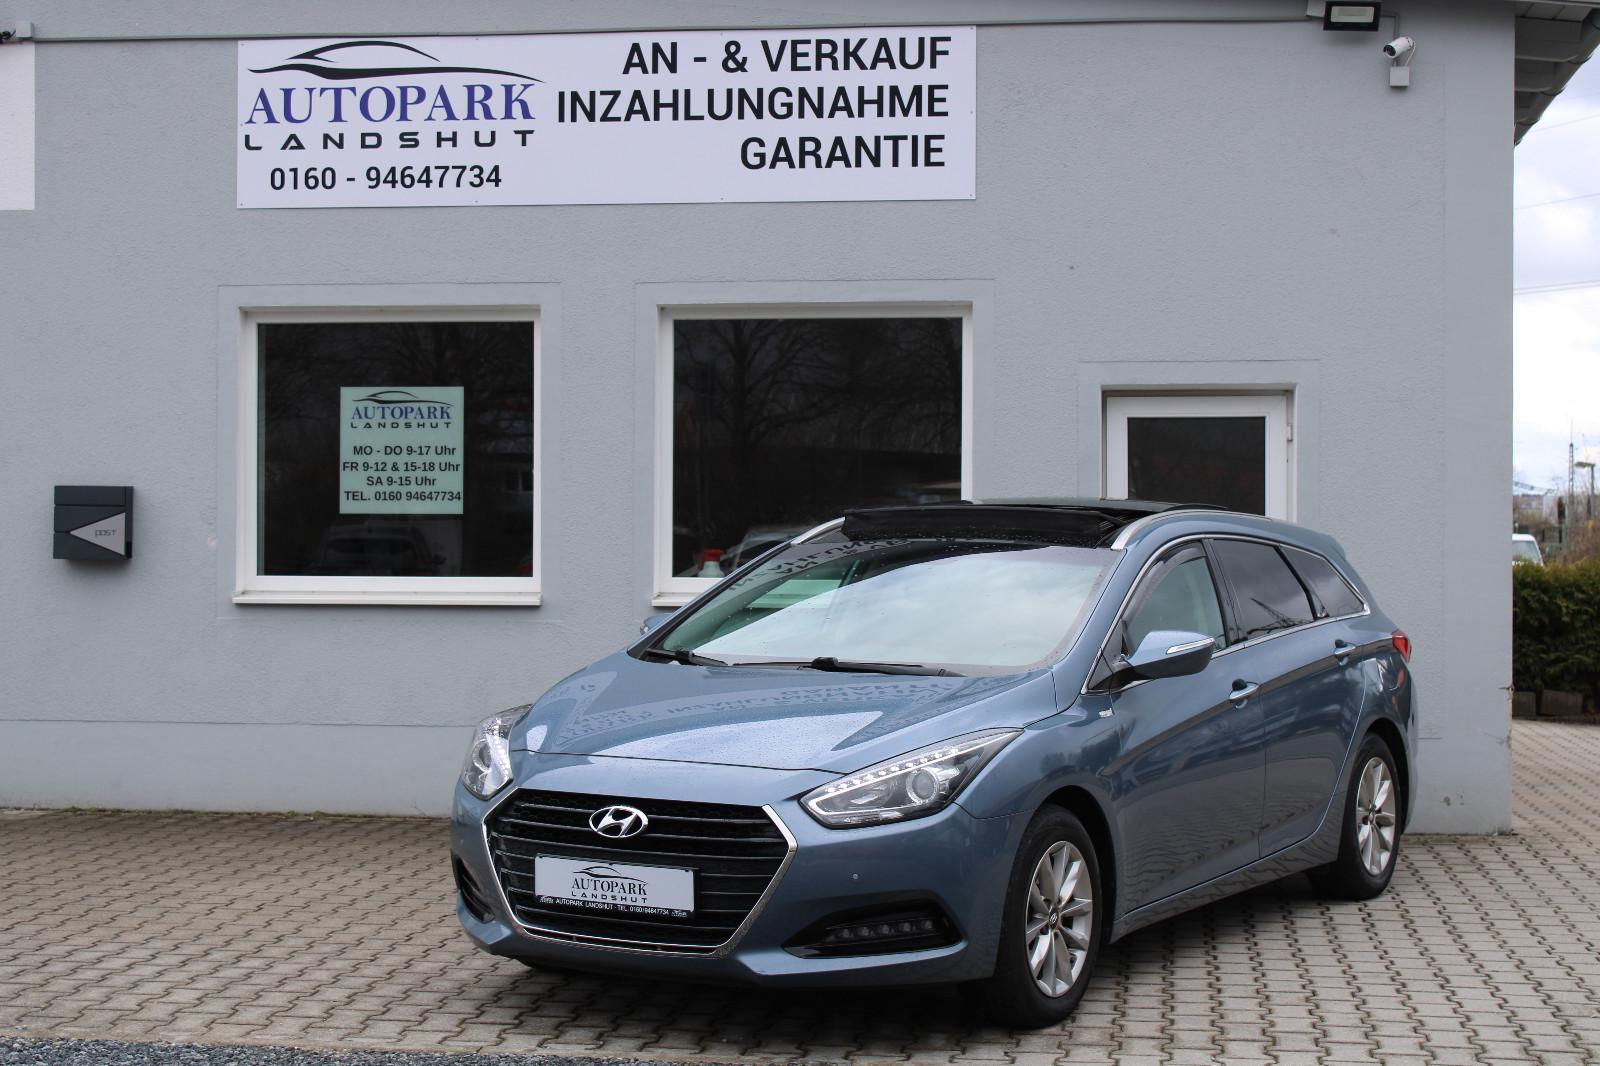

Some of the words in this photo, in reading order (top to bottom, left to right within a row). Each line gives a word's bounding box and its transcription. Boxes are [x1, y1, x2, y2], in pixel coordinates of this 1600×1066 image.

[622, 41, 678, 75] AN
[721, 40, 748, 73] &
[760, 36, 952, 72] VERKAUF
[245, 83, 536, 125] AUTOPARK
[557, 84, 949, 123] INZAHLUNGNAHME
[244, 130, 535, 151] LANDSHUT
[740, 134, 946, 170] GARANTIE
[270, 167, 337, 191] 0160
[365, 165, 502, 189] 94647734
[351, 406, 452, 420] AUTOPARK
[353, 445, 373, 456] MO
[384, 445, 403, 456] DO
[406, 445, 431, 456] 9-17
[434, 445, 457, 456] Uhr
[342, 461, 359, 472] FR
[362, 461, 388, 472] 9-12
[391, 461, 400, 472] &
[403, 461, 436, 472] 15-18
[438, 461, 461, 472] Uhr
[366, 475, 384, 486] SA
[386, 475, 412, 486] 9-15
[415, 475, 437, 486] Uhr
[344, 490, 371, 501] TEL.
[374, 491, 402, 501] 0160
[405, 491, 461, 501] 94647734
[571, 877, 648, 896] AUTOPARK
[555, 897, 584, 907] AUTOPARK
[585, 901, 614, 910] LANDSHUT
[571, 891, 648, 903] LANDSHUT
